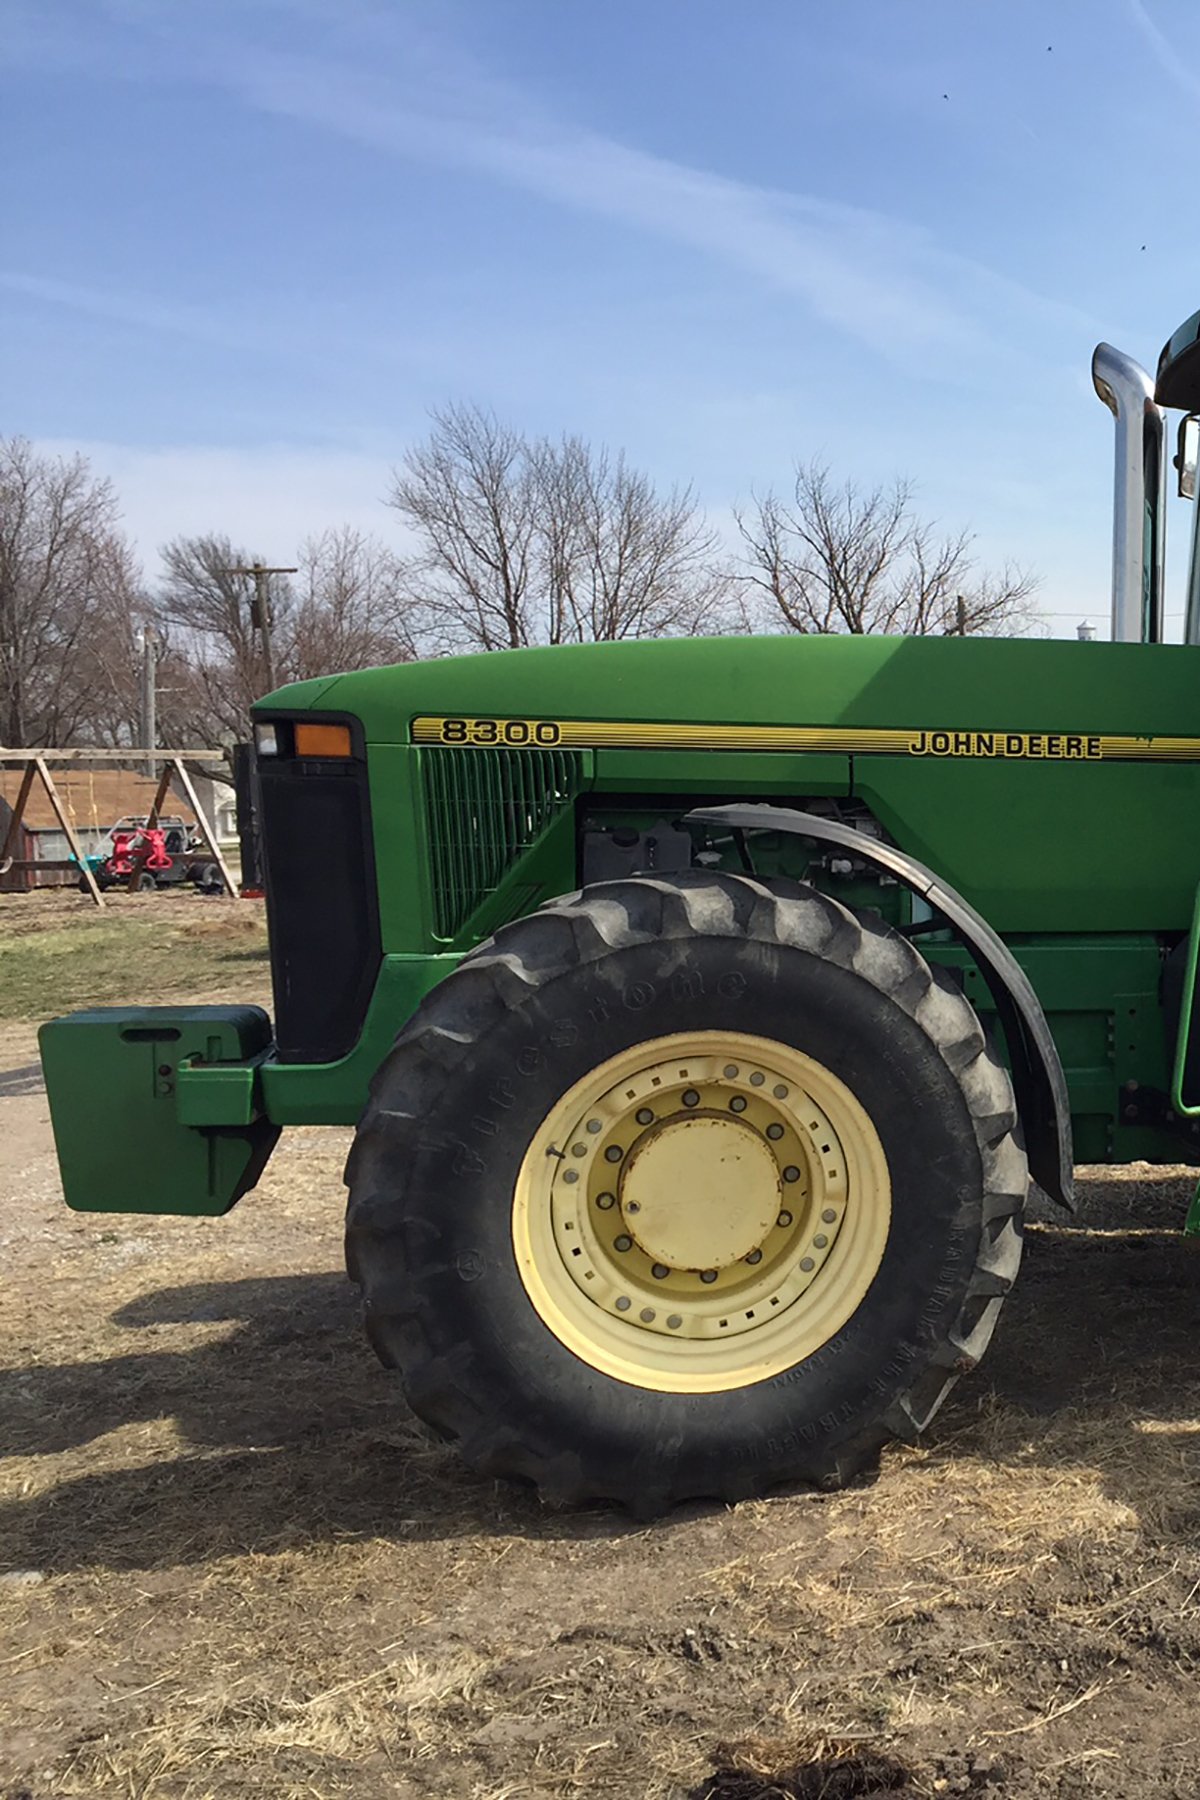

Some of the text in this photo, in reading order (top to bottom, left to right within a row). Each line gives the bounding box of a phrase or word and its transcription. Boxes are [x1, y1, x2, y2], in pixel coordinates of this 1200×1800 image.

[441, 719, 561, 746] 8300
[909, 731, 1102, 759] JOHN DEERE
